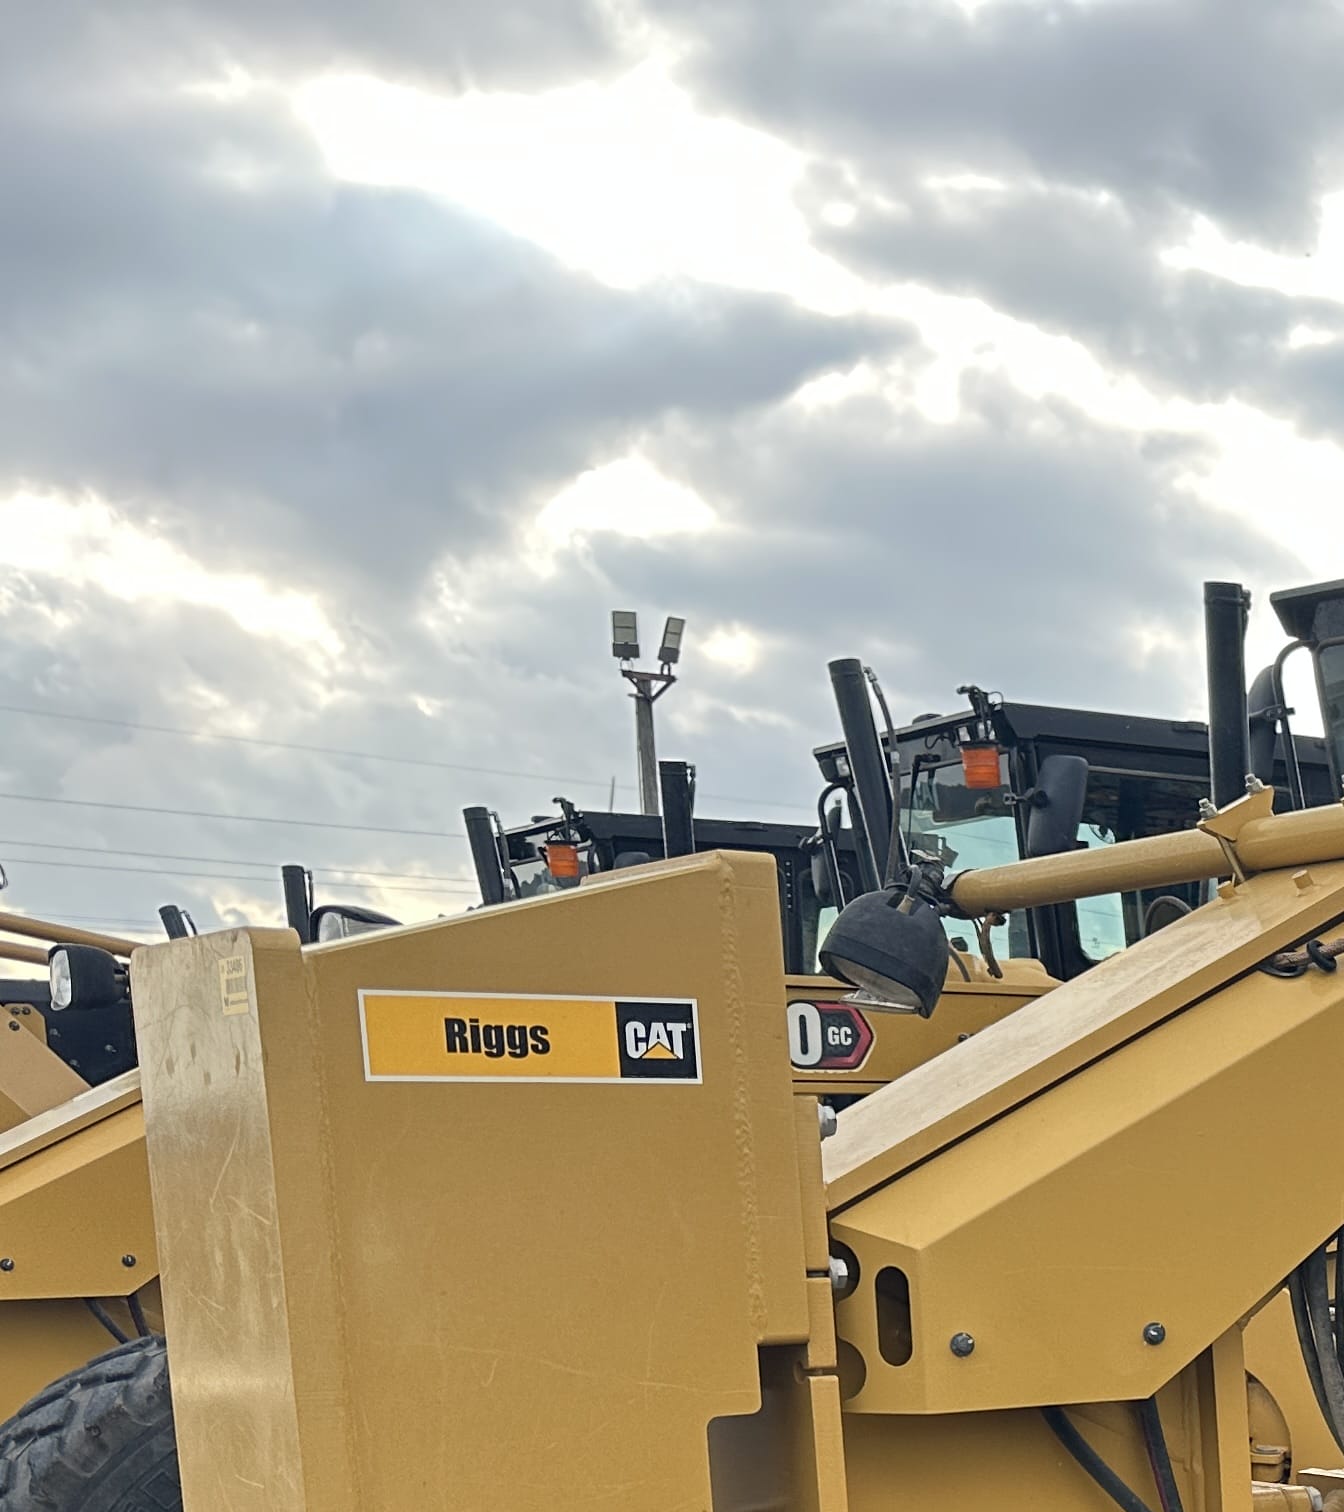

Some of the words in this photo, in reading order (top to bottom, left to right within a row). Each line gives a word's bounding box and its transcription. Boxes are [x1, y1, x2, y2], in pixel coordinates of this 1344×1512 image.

[444, 1018, 551, 1059] Riggs
[625, 1021, 689, 1059] CAT
[827, 1026, 853, 1046] GC
